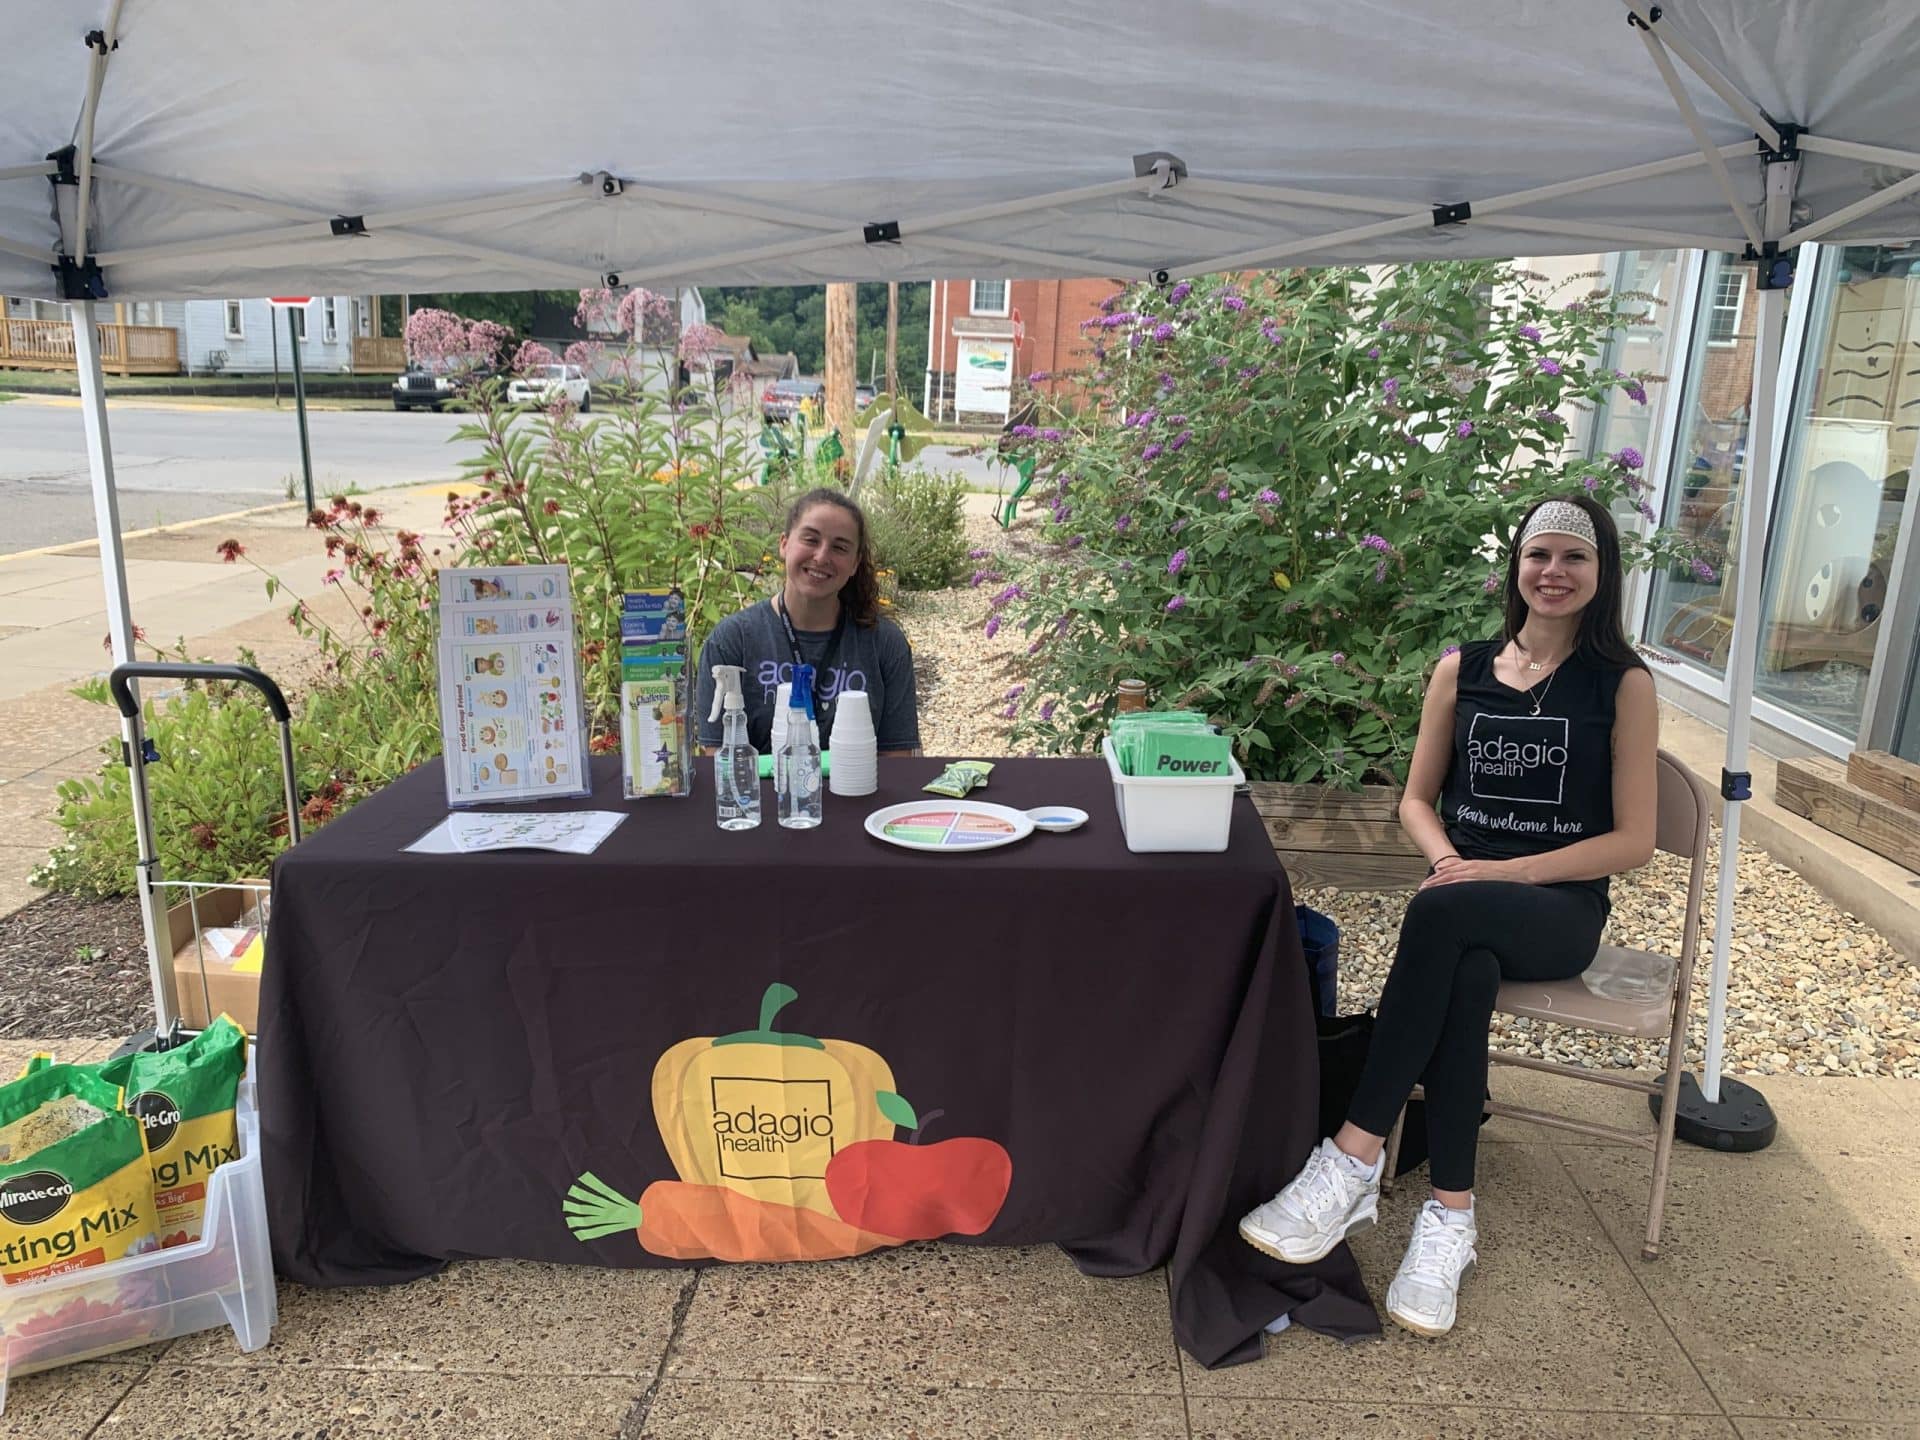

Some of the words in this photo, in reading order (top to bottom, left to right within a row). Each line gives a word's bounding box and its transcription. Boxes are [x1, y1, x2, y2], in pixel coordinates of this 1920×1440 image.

[458, 709, 466, 732] Group
[459, 733, 468, 752] Food
[1467, 735, 1568, 768] adagio
[1157, 755, 1222, 773] Power
[1474, 758, 1524, 776] health
[1490, 812, 1548, 832] welcome
[1553, 816, 1583, 833] here
[713, 1105, 833, 1143] adagio
[722, 1134, 784, 1153] health
[184, 1144, 235, 1175] Mix
[81, 1202, 138, 1242] Mix
